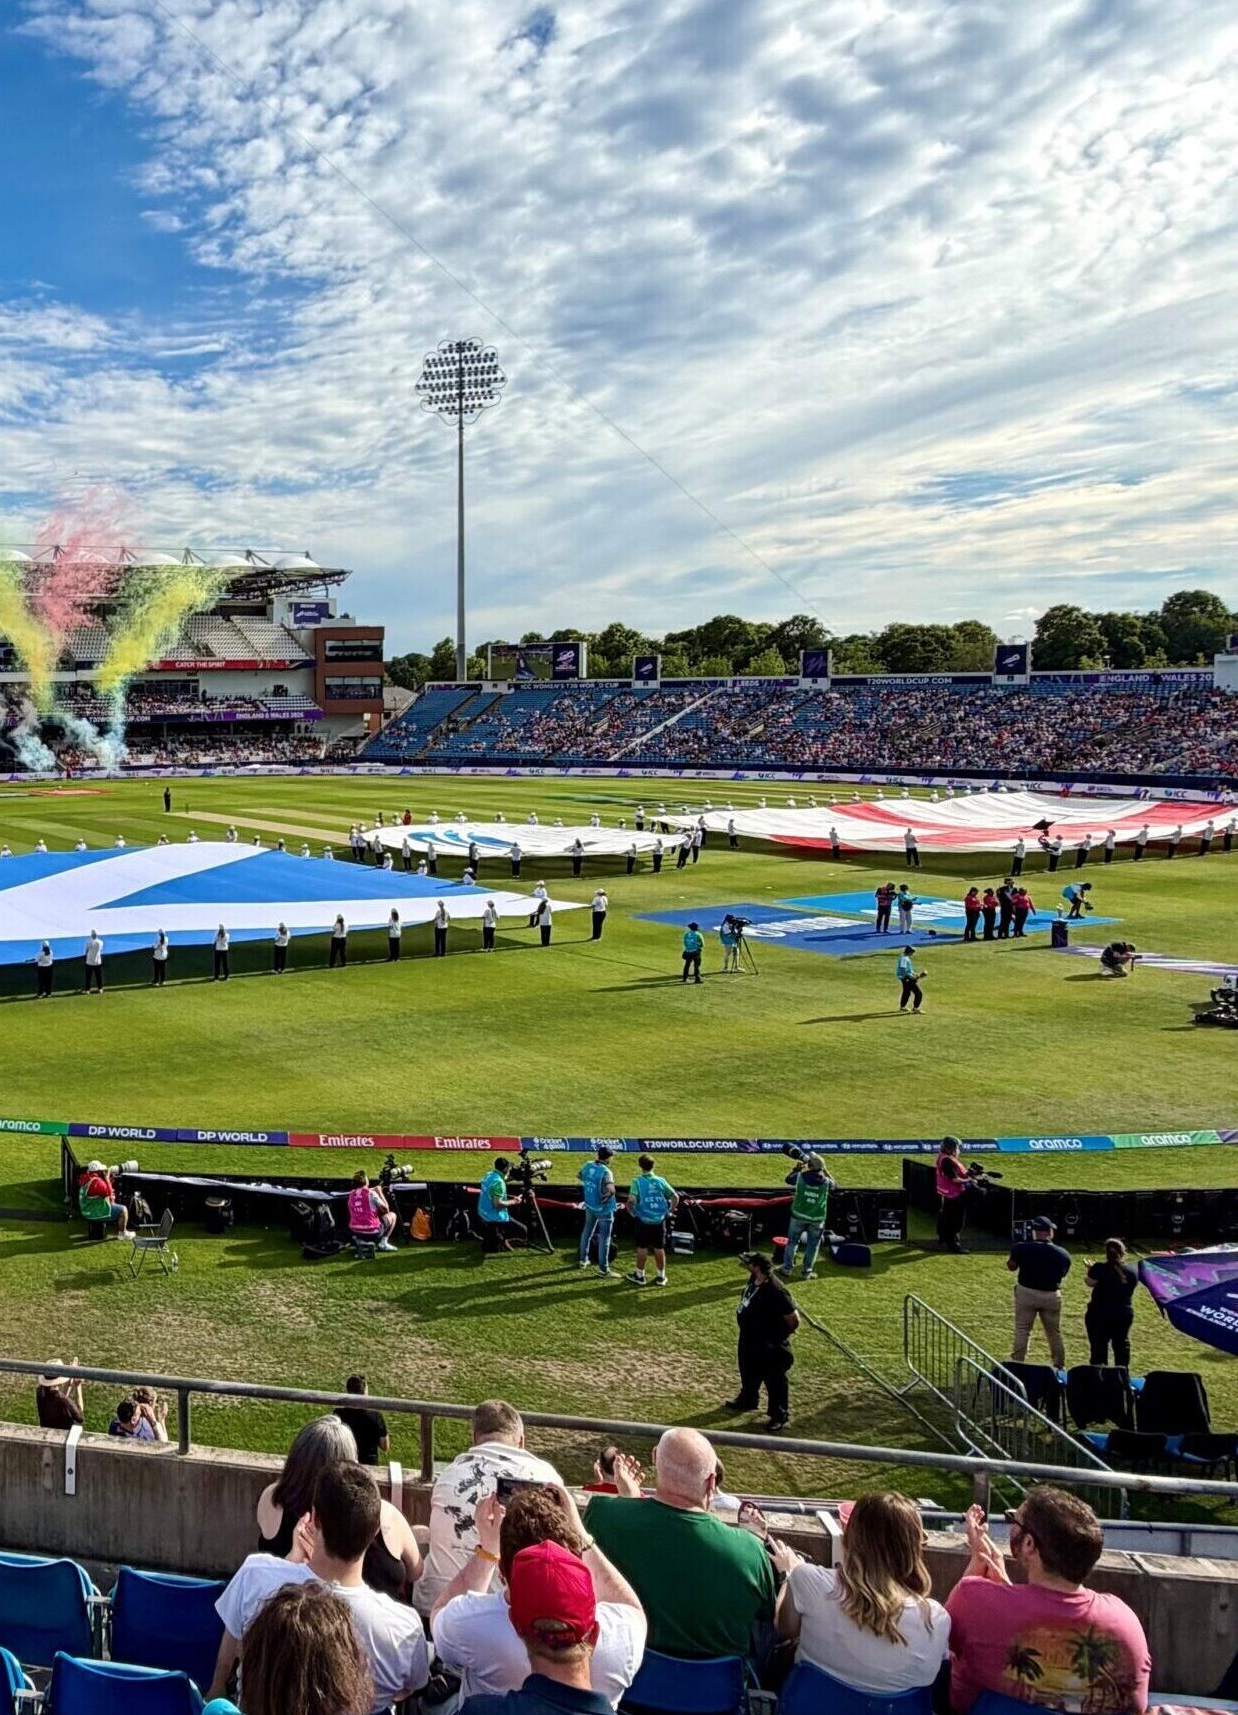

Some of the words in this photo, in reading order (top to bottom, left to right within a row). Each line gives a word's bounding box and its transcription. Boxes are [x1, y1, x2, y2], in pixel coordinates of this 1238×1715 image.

[866, 677, 953, 686] T20WORLDCUP.COM
[1099, 674, 1150, 683] ENGLAND
[1161, 673, 1197, 683] WALES
[88, 1125, 106, 1136] DP
[107, 1127, 156, 1139] WORLD
[197, 1130, 216, 1141] DP
[216, 1131, 268, 1144] WORLD
[319, 1134, 375, 1148] Emirates
[434, 1136, 491, 1150] Emirates
[644, 1139, 738, 1150] T20WORLDCUP.COM
[1029, 1137, 1083, 1150] aramco
[1140, 1133, 1191, 1146] aramco
